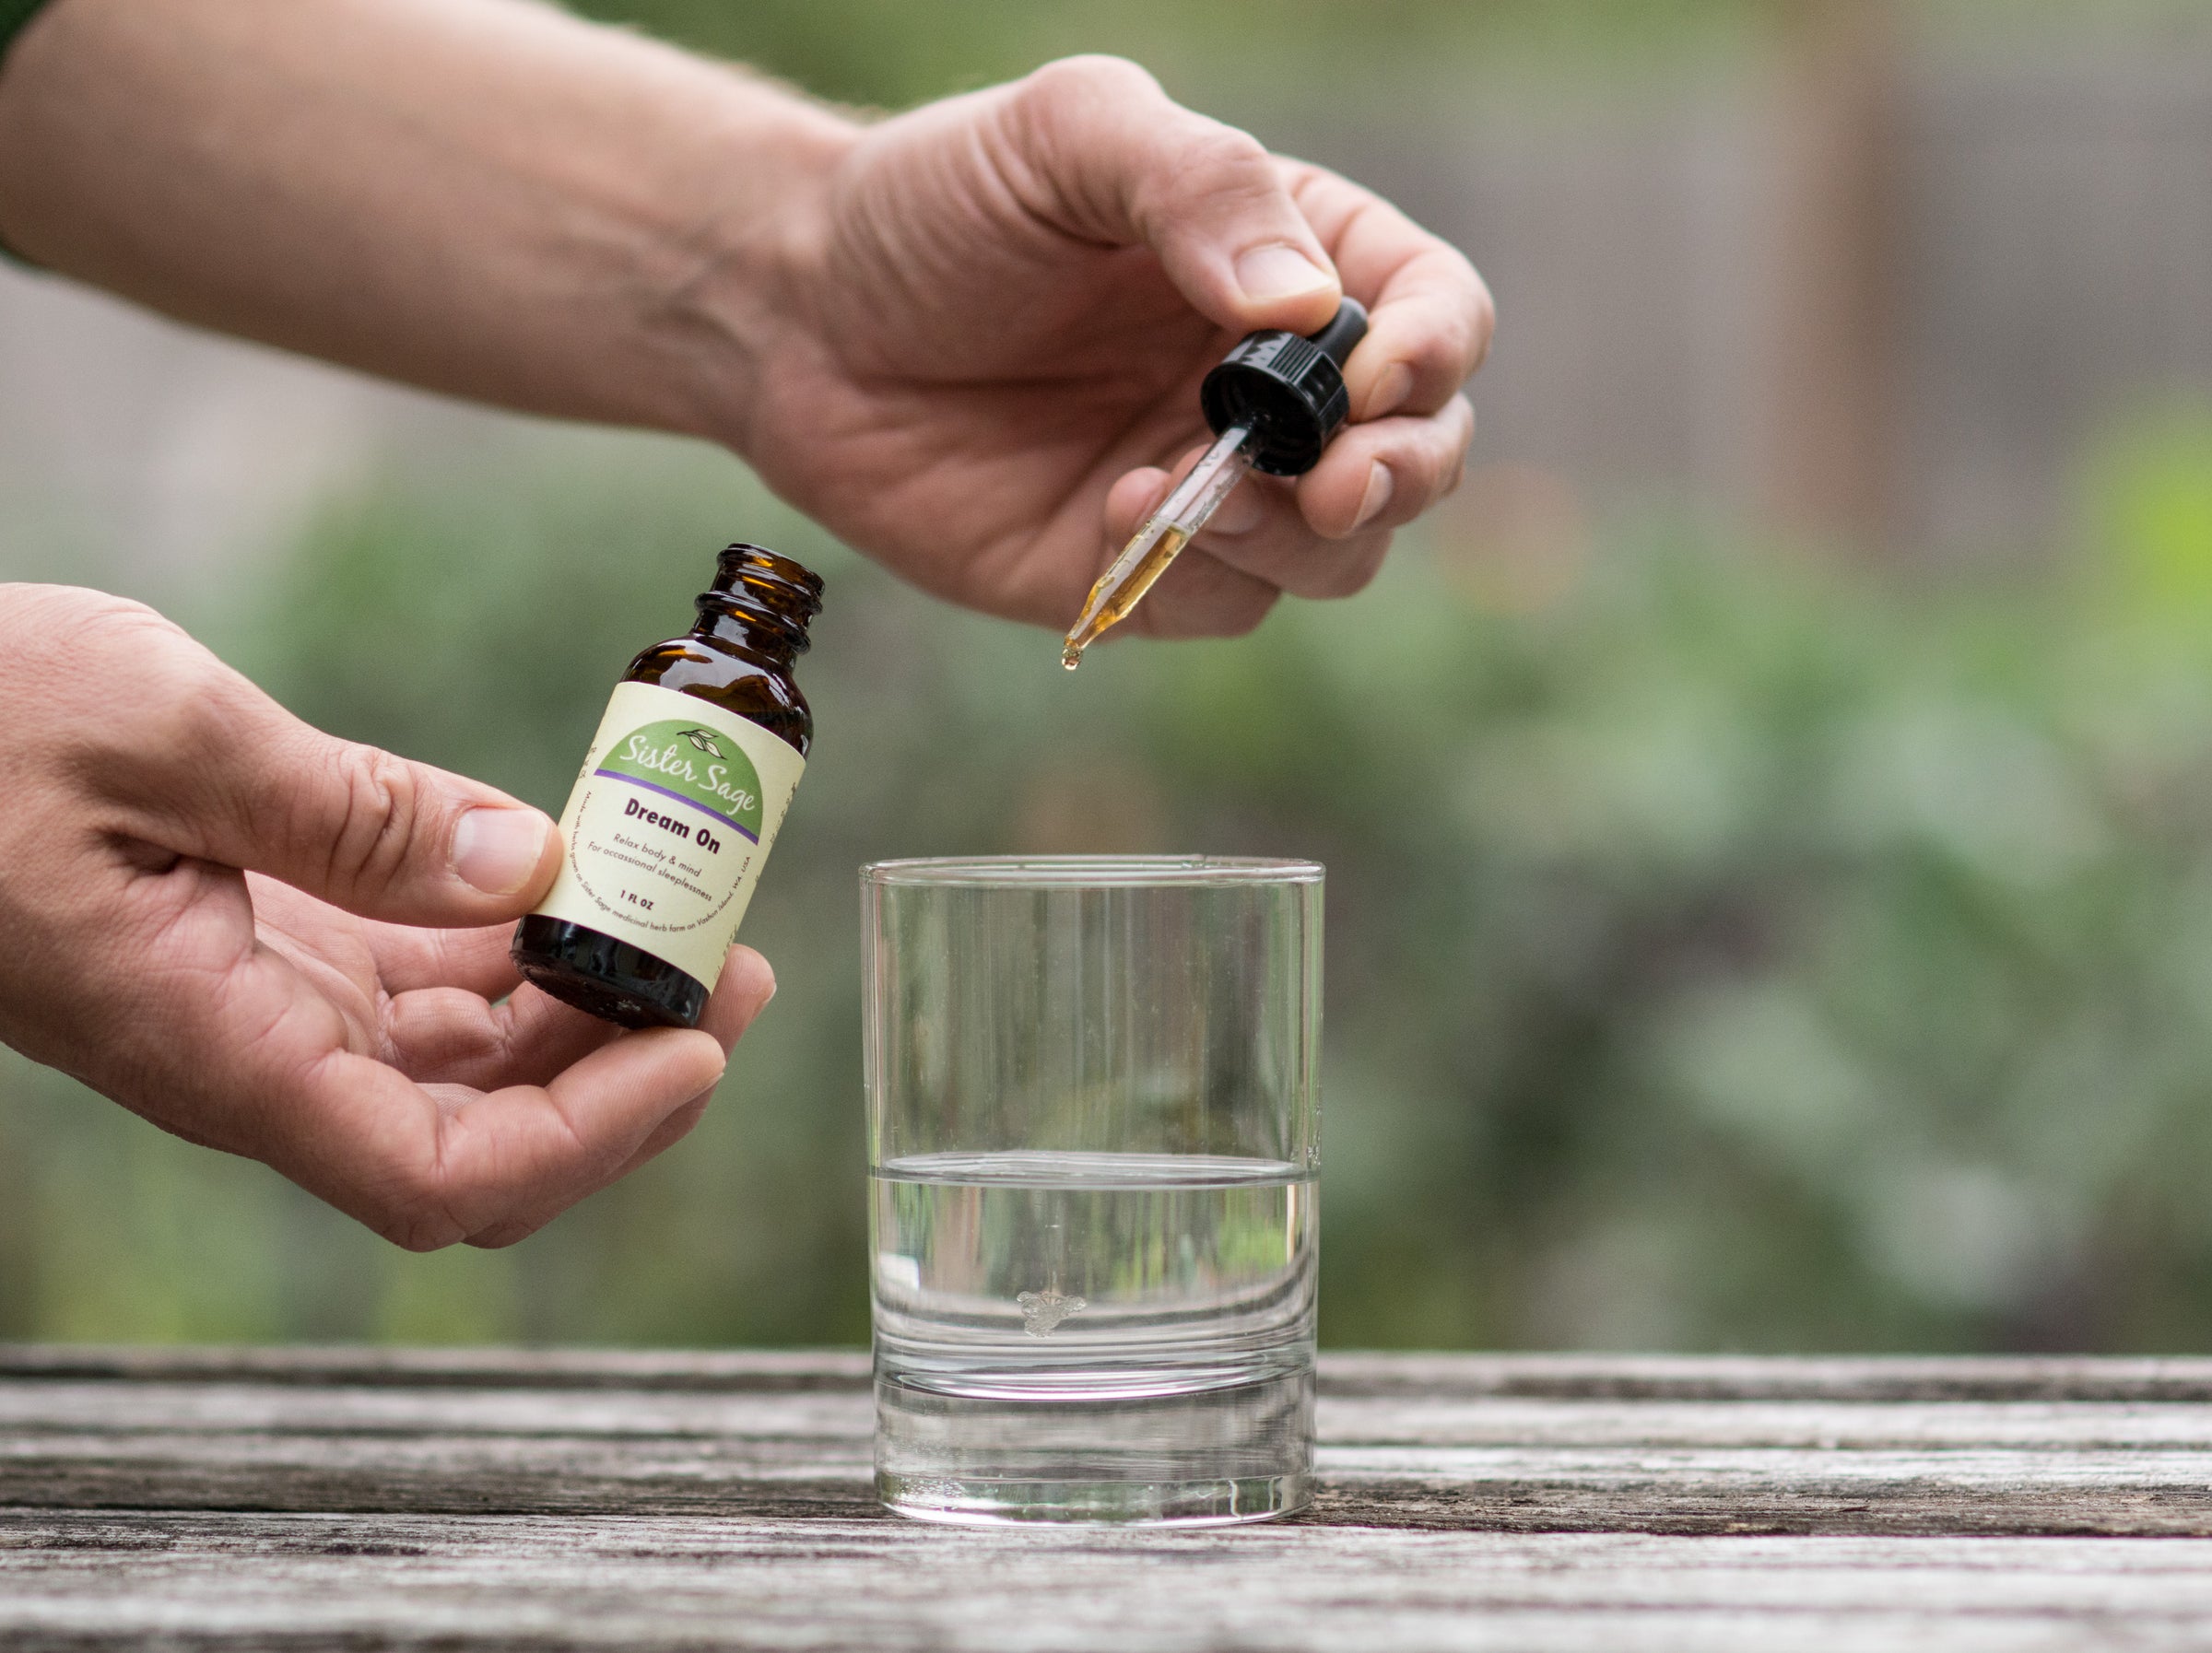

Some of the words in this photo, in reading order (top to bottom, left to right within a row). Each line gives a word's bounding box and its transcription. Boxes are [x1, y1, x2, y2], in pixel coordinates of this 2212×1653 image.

[619, 735, 698, 781] Sister
[698, 764, 756, 815] Sage
[613, 833, 640, 850] Relax
[641, 843, 666, 862] body
[668, 856, 677, 865] &
[678, 862, 702, 877] mind
[624, 797, 690, 838] Dream
[696, 828, 721, 855] On
[575, 873, 582, 882] on
[581, 881, 595, 898] Sister
[594, 896, 611, 911] Sage
[612, 910, 649, 928] medicinal
[649, 920, 667, 932] herb
[669, 923, 686, 932] farm
[687, 922, 696, 931] on
[696, 909, 718, 926] Vashon
[741, 856, 751, 873] USA
[587, 840, 602, 852] For
[603, 848, 657, 873] occassional
[657, 868, 713, 902] sleeplessness
[620, 889, 626, 898] 1
[628, 893, 638, 904] FL
[640, 898, 654, 910] OZ
